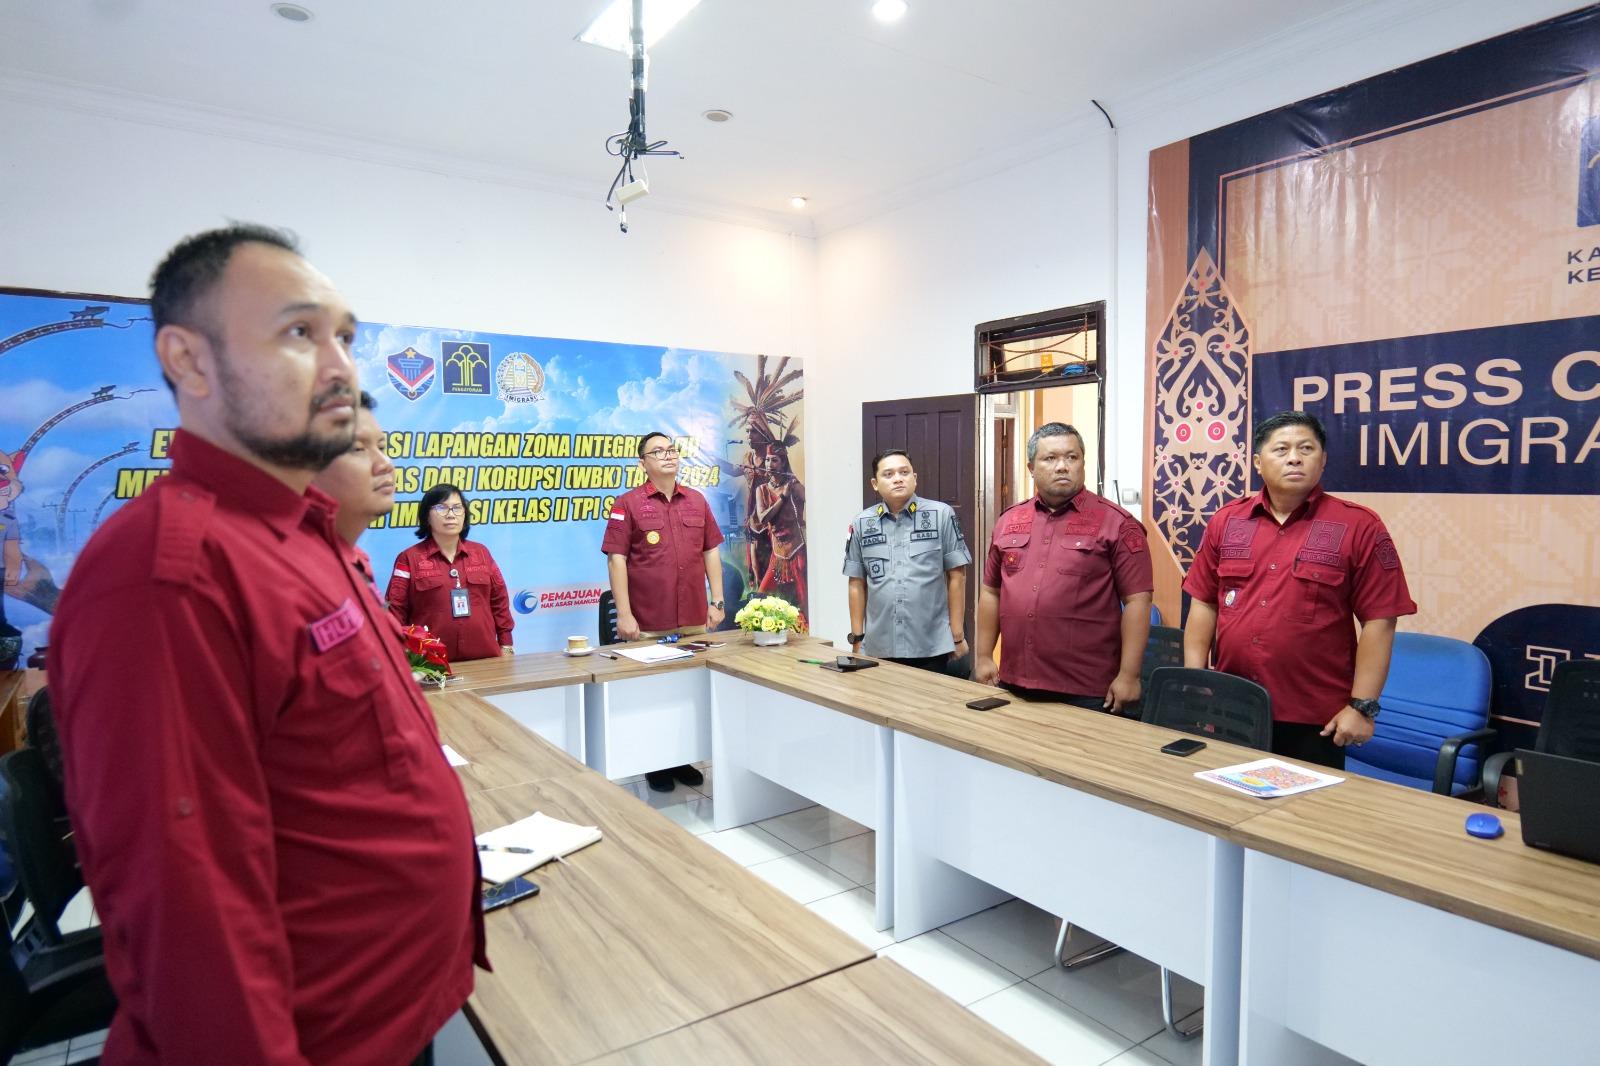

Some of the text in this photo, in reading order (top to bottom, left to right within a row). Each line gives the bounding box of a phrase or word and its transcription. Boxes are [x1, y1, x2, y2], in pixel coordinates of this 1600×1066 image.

[1293, 350, 1600, 414] PRESS C
[504, 394, 539, 403] IMIGRASI
[413, 431, 522, 459] LAPANGAN
[521, 433, 572, 459] ZONA
[422, 465, 475, 493] DARI
[476, 464, 564, 492] KORUPSI
[563, 464, 622, 490] (WBK)
[679, 464, 720, 488] 2024
[491, 497, 553, 525] KELAS
[552, 497, 570, 523] II
[571, 496, 601, 522] TPI
[540, 588, 601, 602] PEMAJUAN
